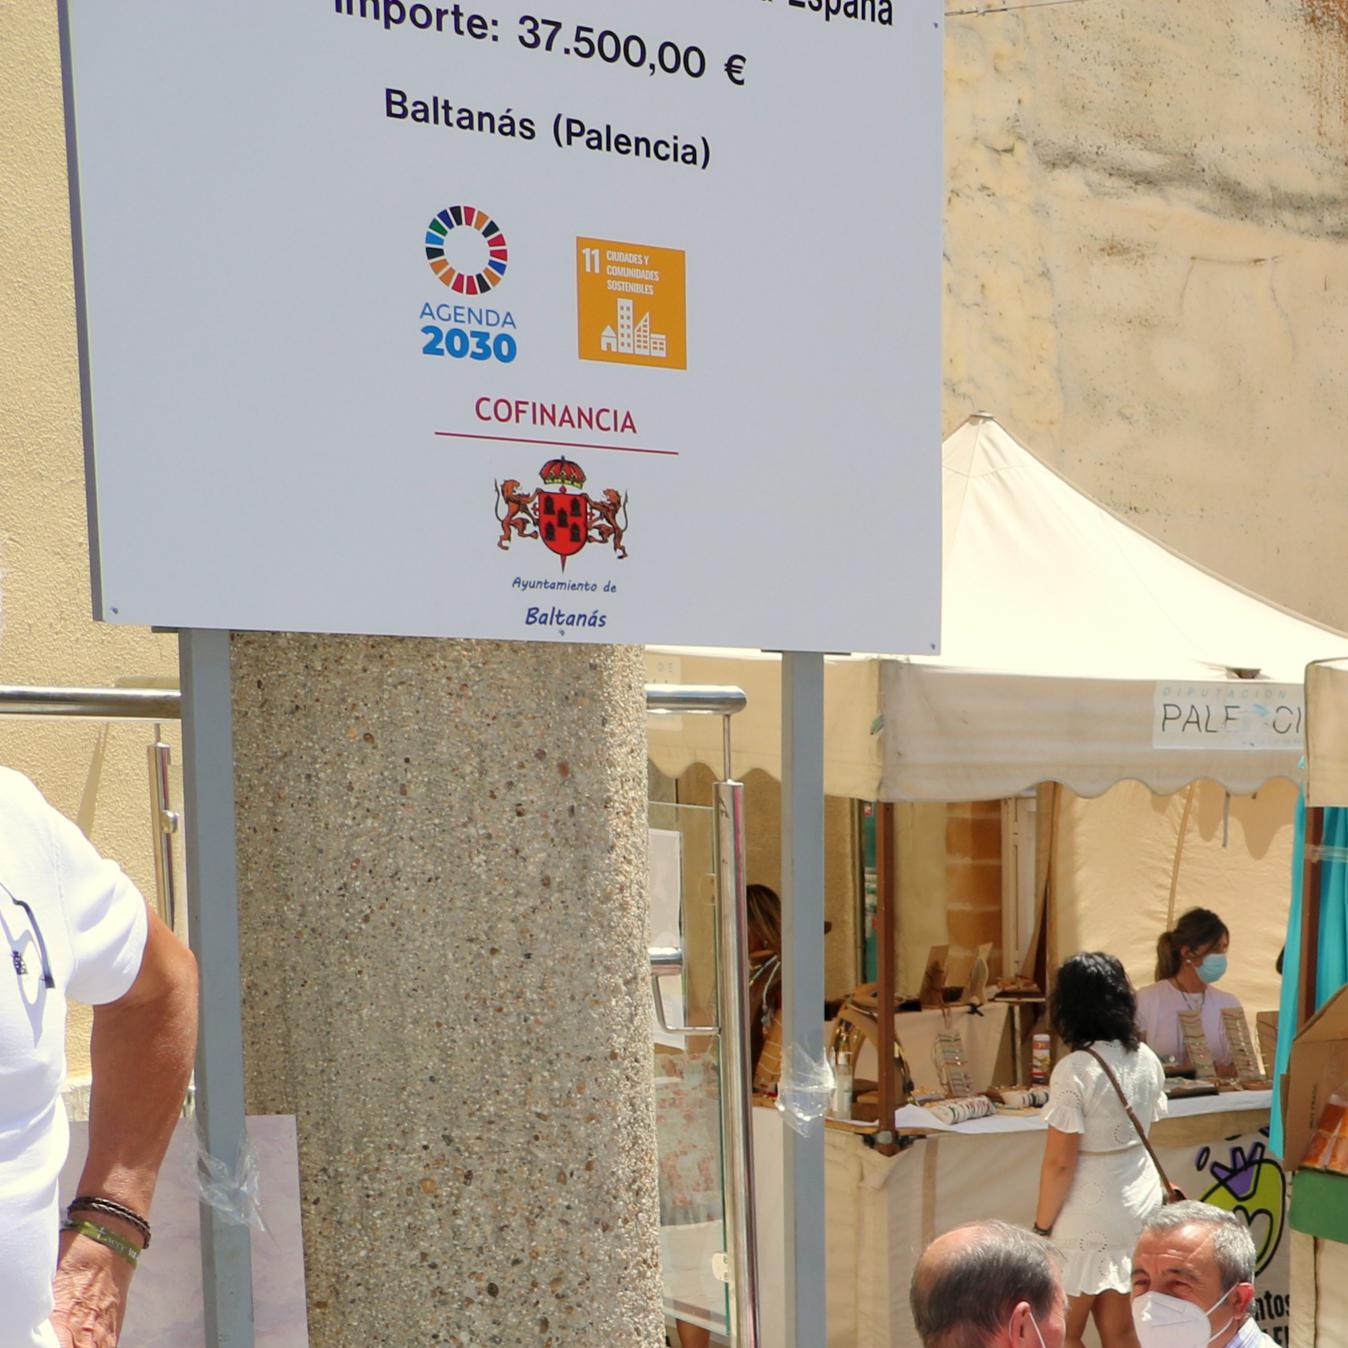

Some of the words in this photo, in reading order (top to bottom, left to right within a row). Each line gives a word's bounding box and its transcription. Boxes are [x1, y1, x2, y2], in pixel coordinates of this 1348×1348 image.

[518, 15, 707, 78] 37.500,00
[724, 54, 747, 86] €
[385, 87, 536, 141] Baltanás
[552, 113, 711, 170] (Palencia)
[582, 248, 601, 274] 11
[606, 250, 643, 265] CIUDADES
[643, 255, 650, 265] Y
[606, 264, 660, 281] COMUNIDADES
[606, 279, 655, 295] SOSTENIBLES
[419, 302, 517, 329] AGENDA
[420, 325, 517, 363] 2030
[475, 396, 638, 434] COFINANCIA
[511, 577, 598, 593] Ayuntamiento
[603, 580, 617, 593] de
[524, 606, 607, 628] Baltanás
